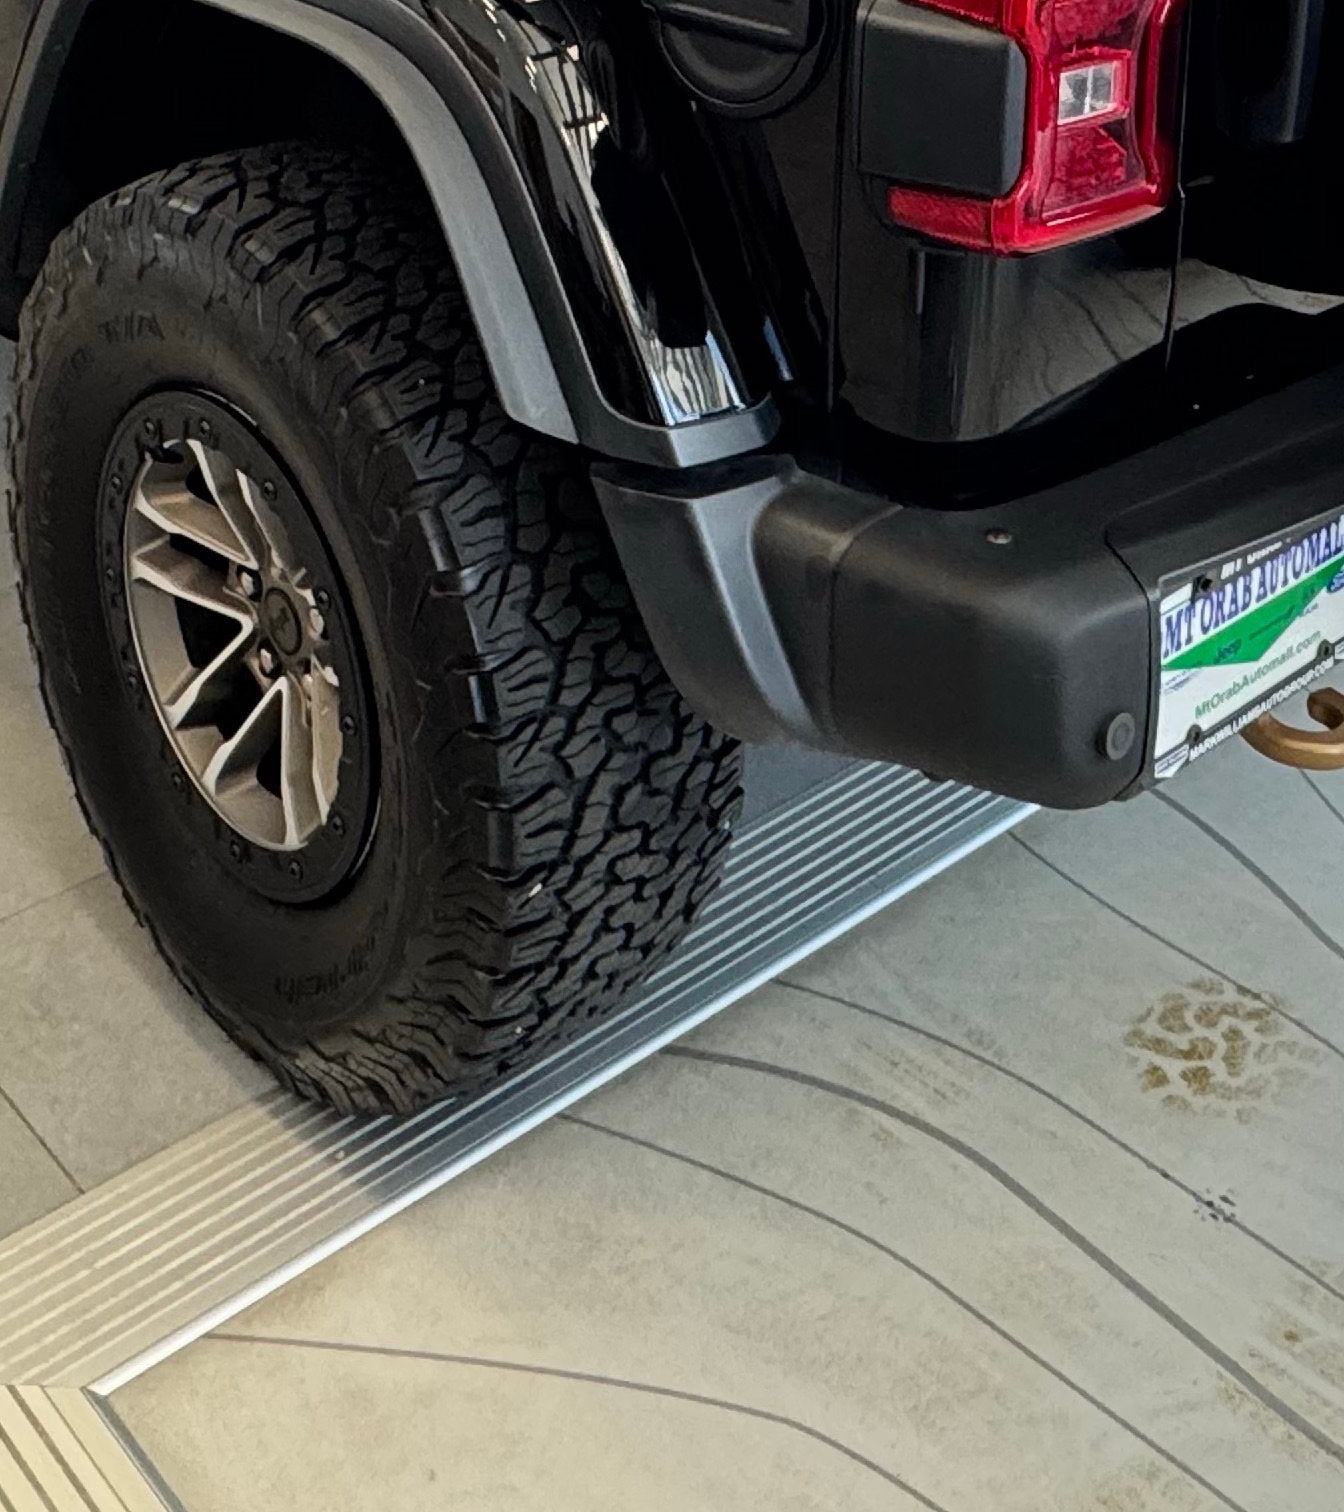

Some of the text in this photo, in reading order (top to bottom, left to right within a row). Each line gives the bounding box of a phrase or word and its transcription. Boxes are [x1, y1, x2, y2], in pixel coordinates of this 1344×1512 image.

[1162, 601, 1196, 660] MT
[1199, 574, 1252, 636] ORAB
[1194, 630, 1321, 720] MtOrabAutomall.com
